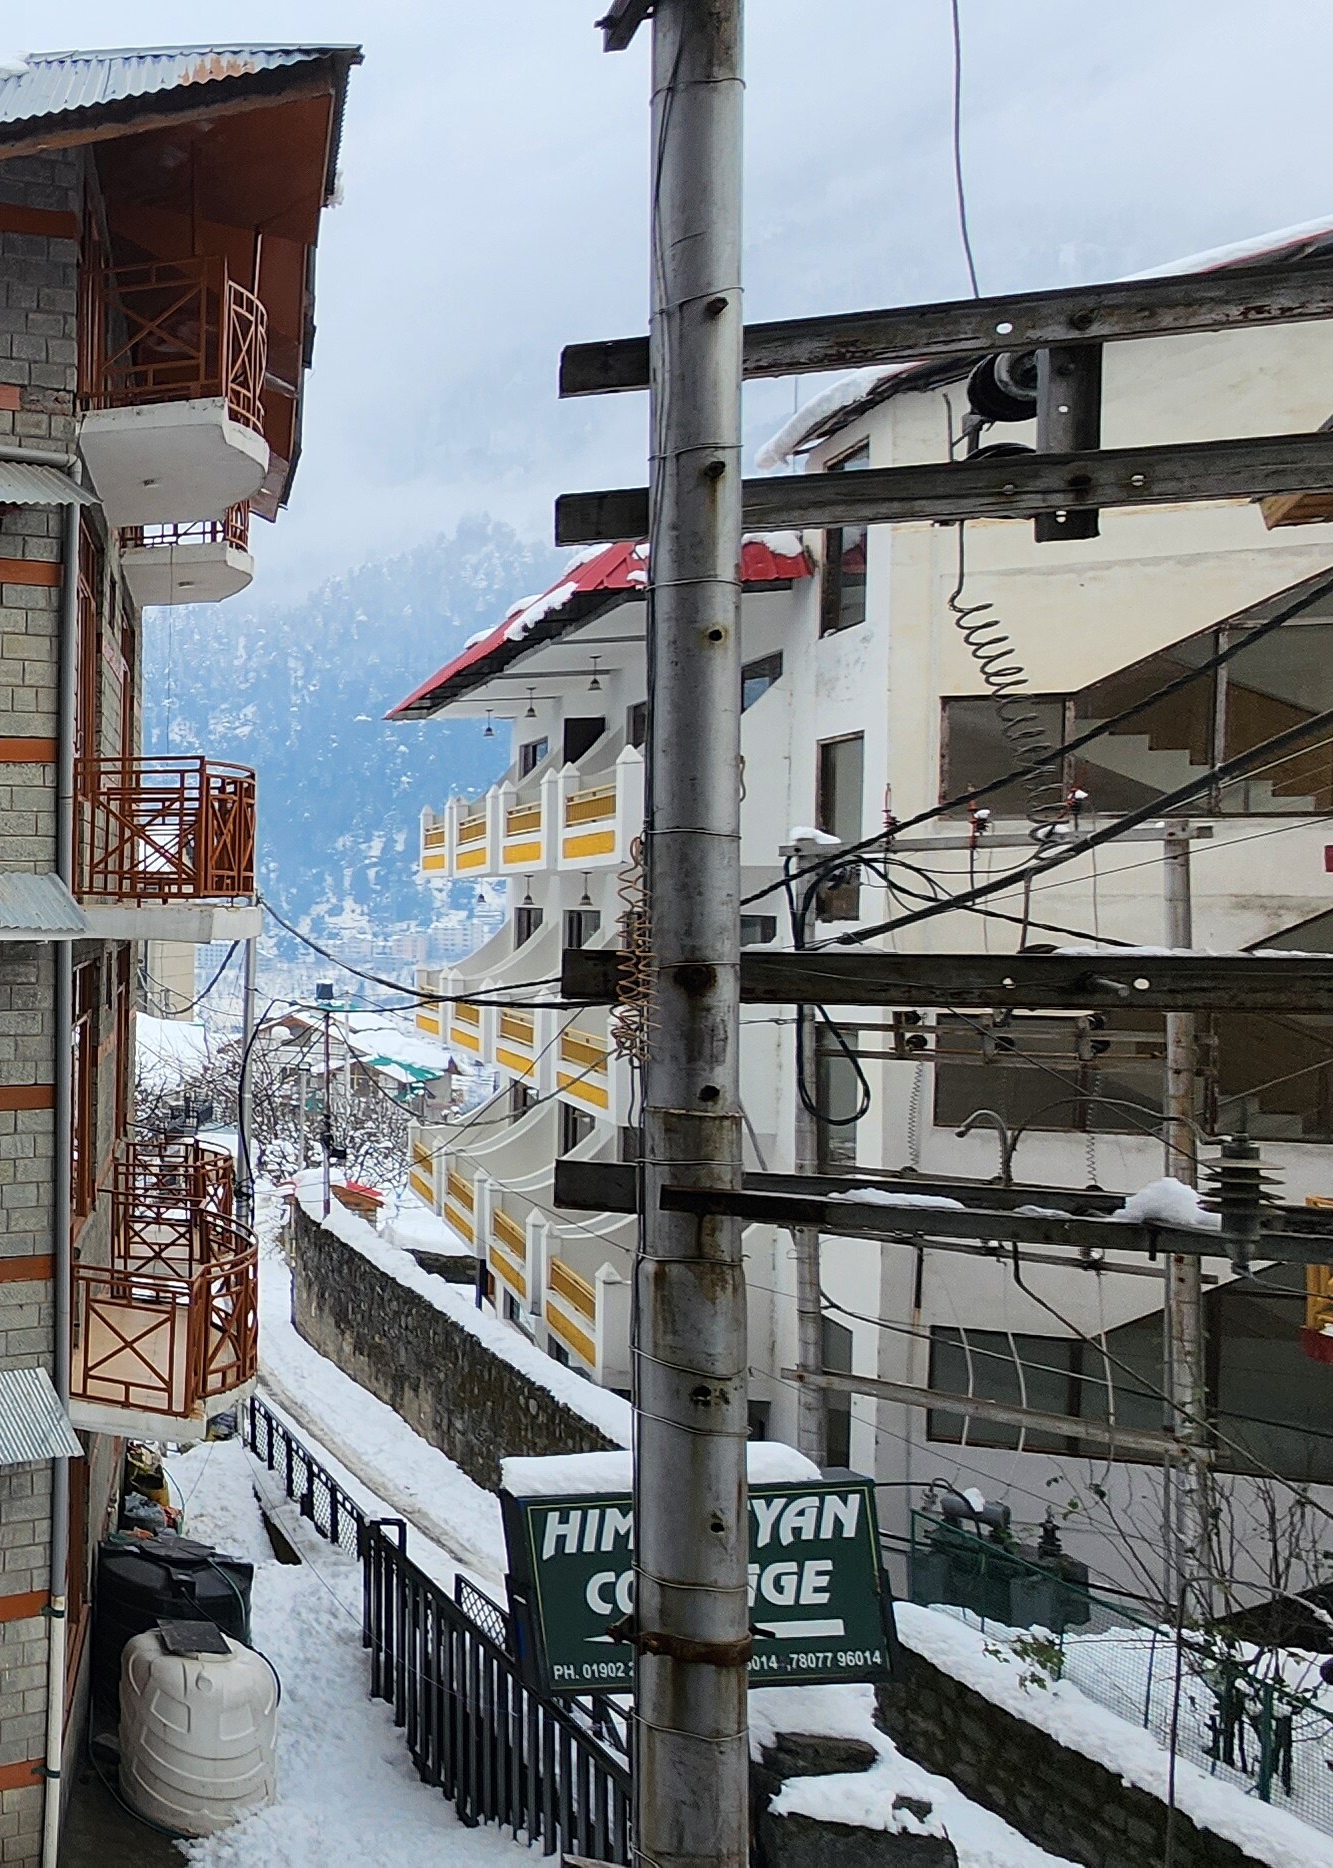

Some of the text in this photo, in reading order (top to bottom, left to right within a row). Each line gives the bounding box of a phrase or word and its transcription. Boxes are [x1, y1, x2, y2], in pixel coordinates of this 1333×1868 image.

[542, 1494, 861, 1560] HIMYAN
[553, 1664, 580, 1681] PH.
[582, 1661, 626, 1680] 01902
[836, 1650, 882, 1667] 96014
